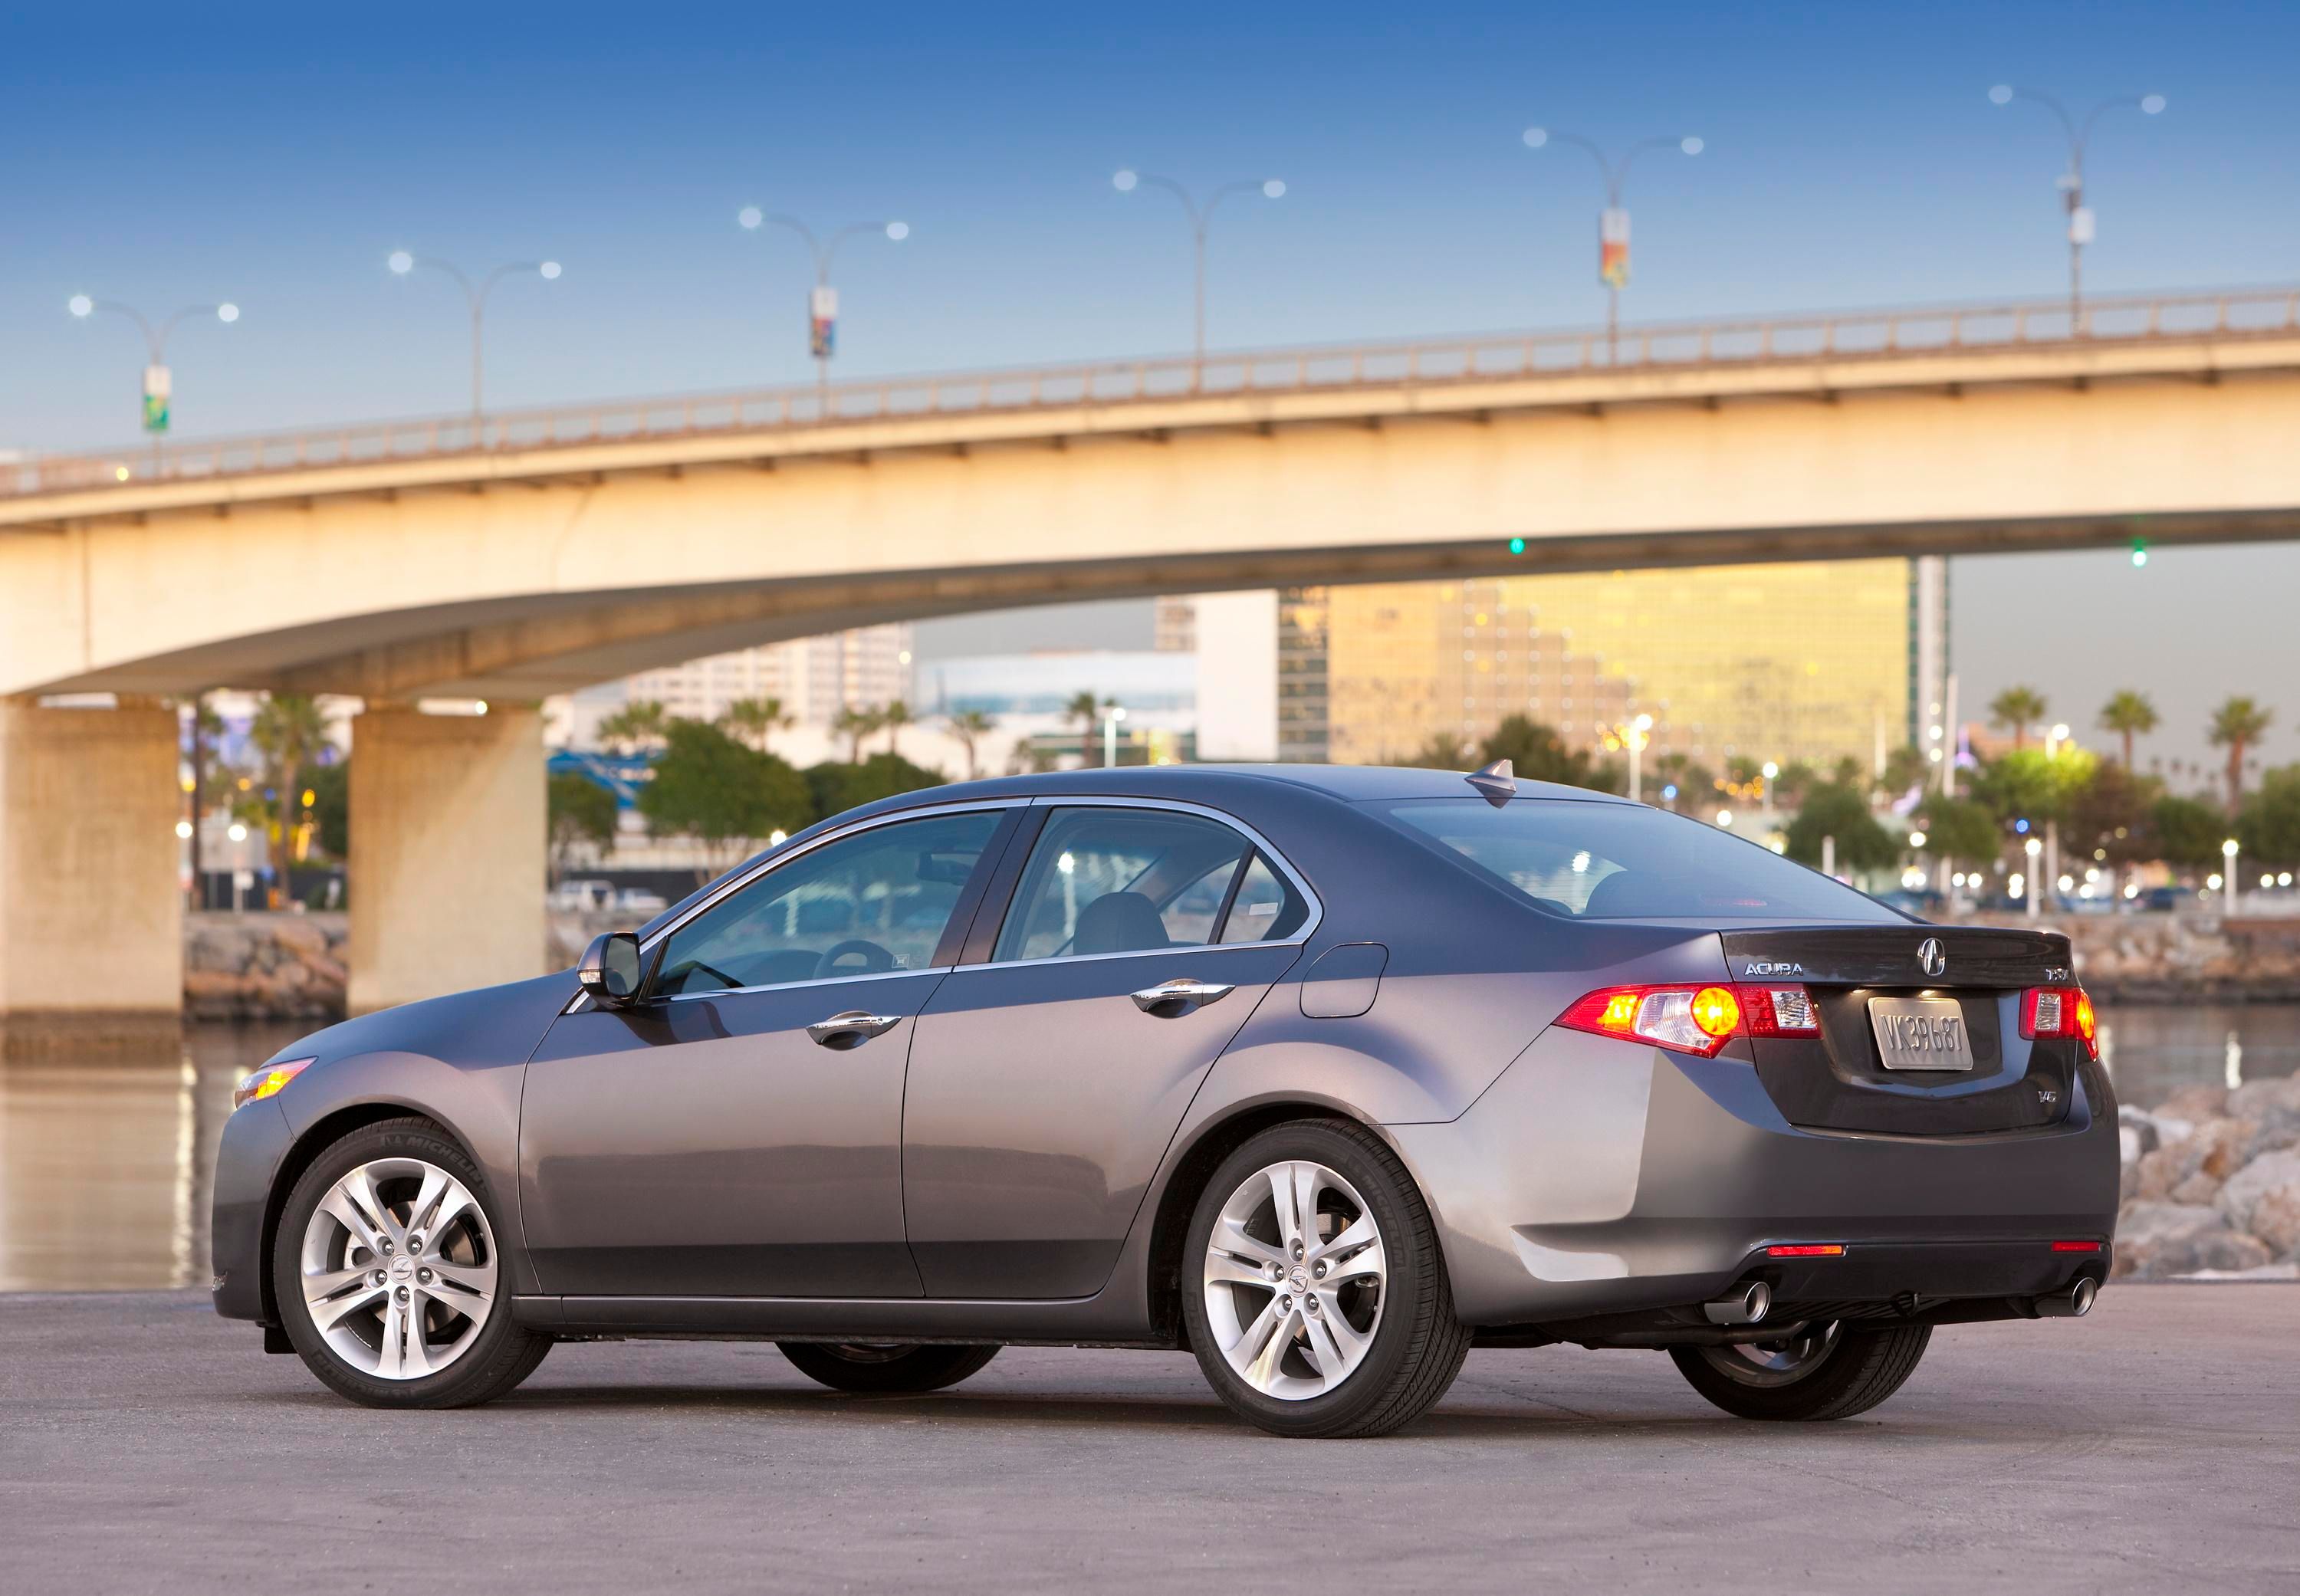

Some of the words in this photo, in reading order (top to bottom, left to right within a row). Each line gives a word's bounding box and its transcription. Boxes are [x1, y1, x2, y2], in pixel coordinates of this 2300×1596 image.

[1745, 963, 1803, 976] ACURA
[1881, 1015, 1962, 1051] VK39687
[407, 1137, 484, 1184] MICHELIN
